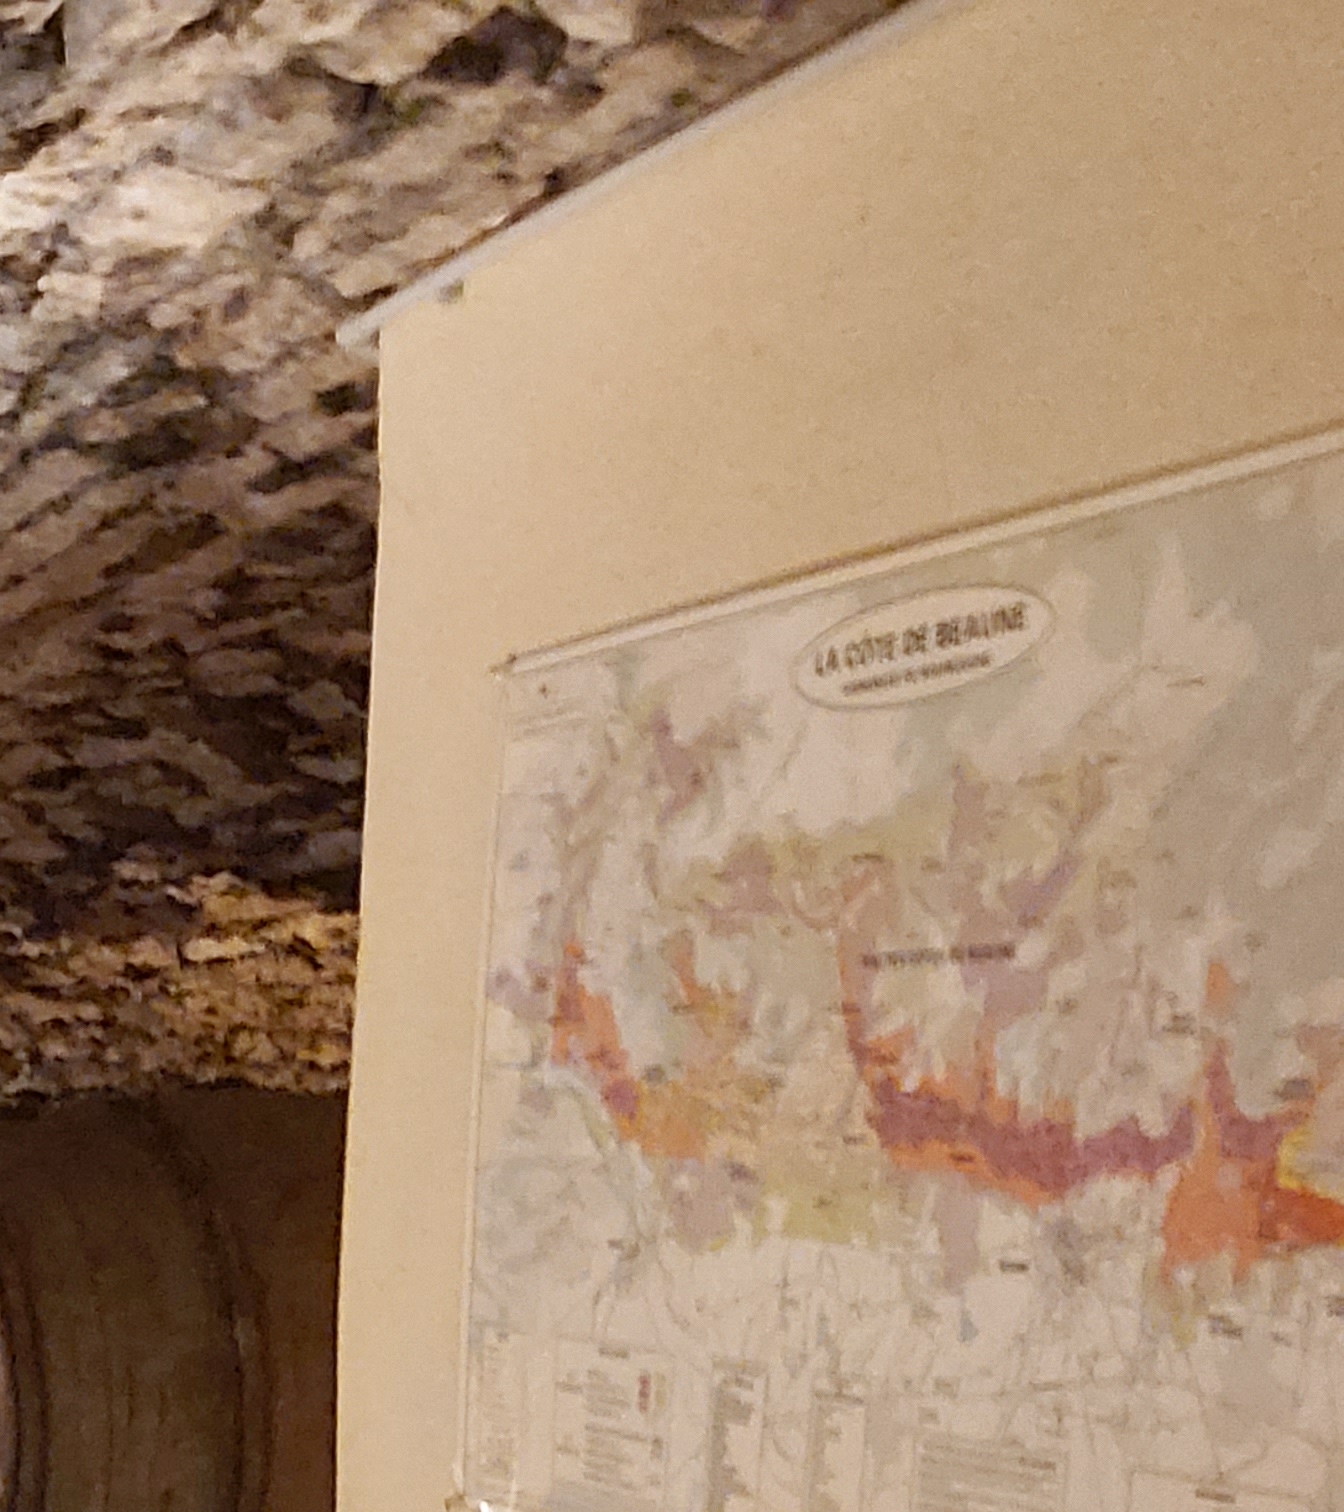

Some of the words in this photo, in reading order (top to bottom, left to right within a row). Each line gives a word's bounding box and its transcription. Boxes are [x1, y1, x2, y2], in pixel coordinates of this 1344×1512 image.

[814, 645, 840, 677] LA
[902, 622, 928, 655] DE
[935, 601, 1027, 648] BEAUNE
